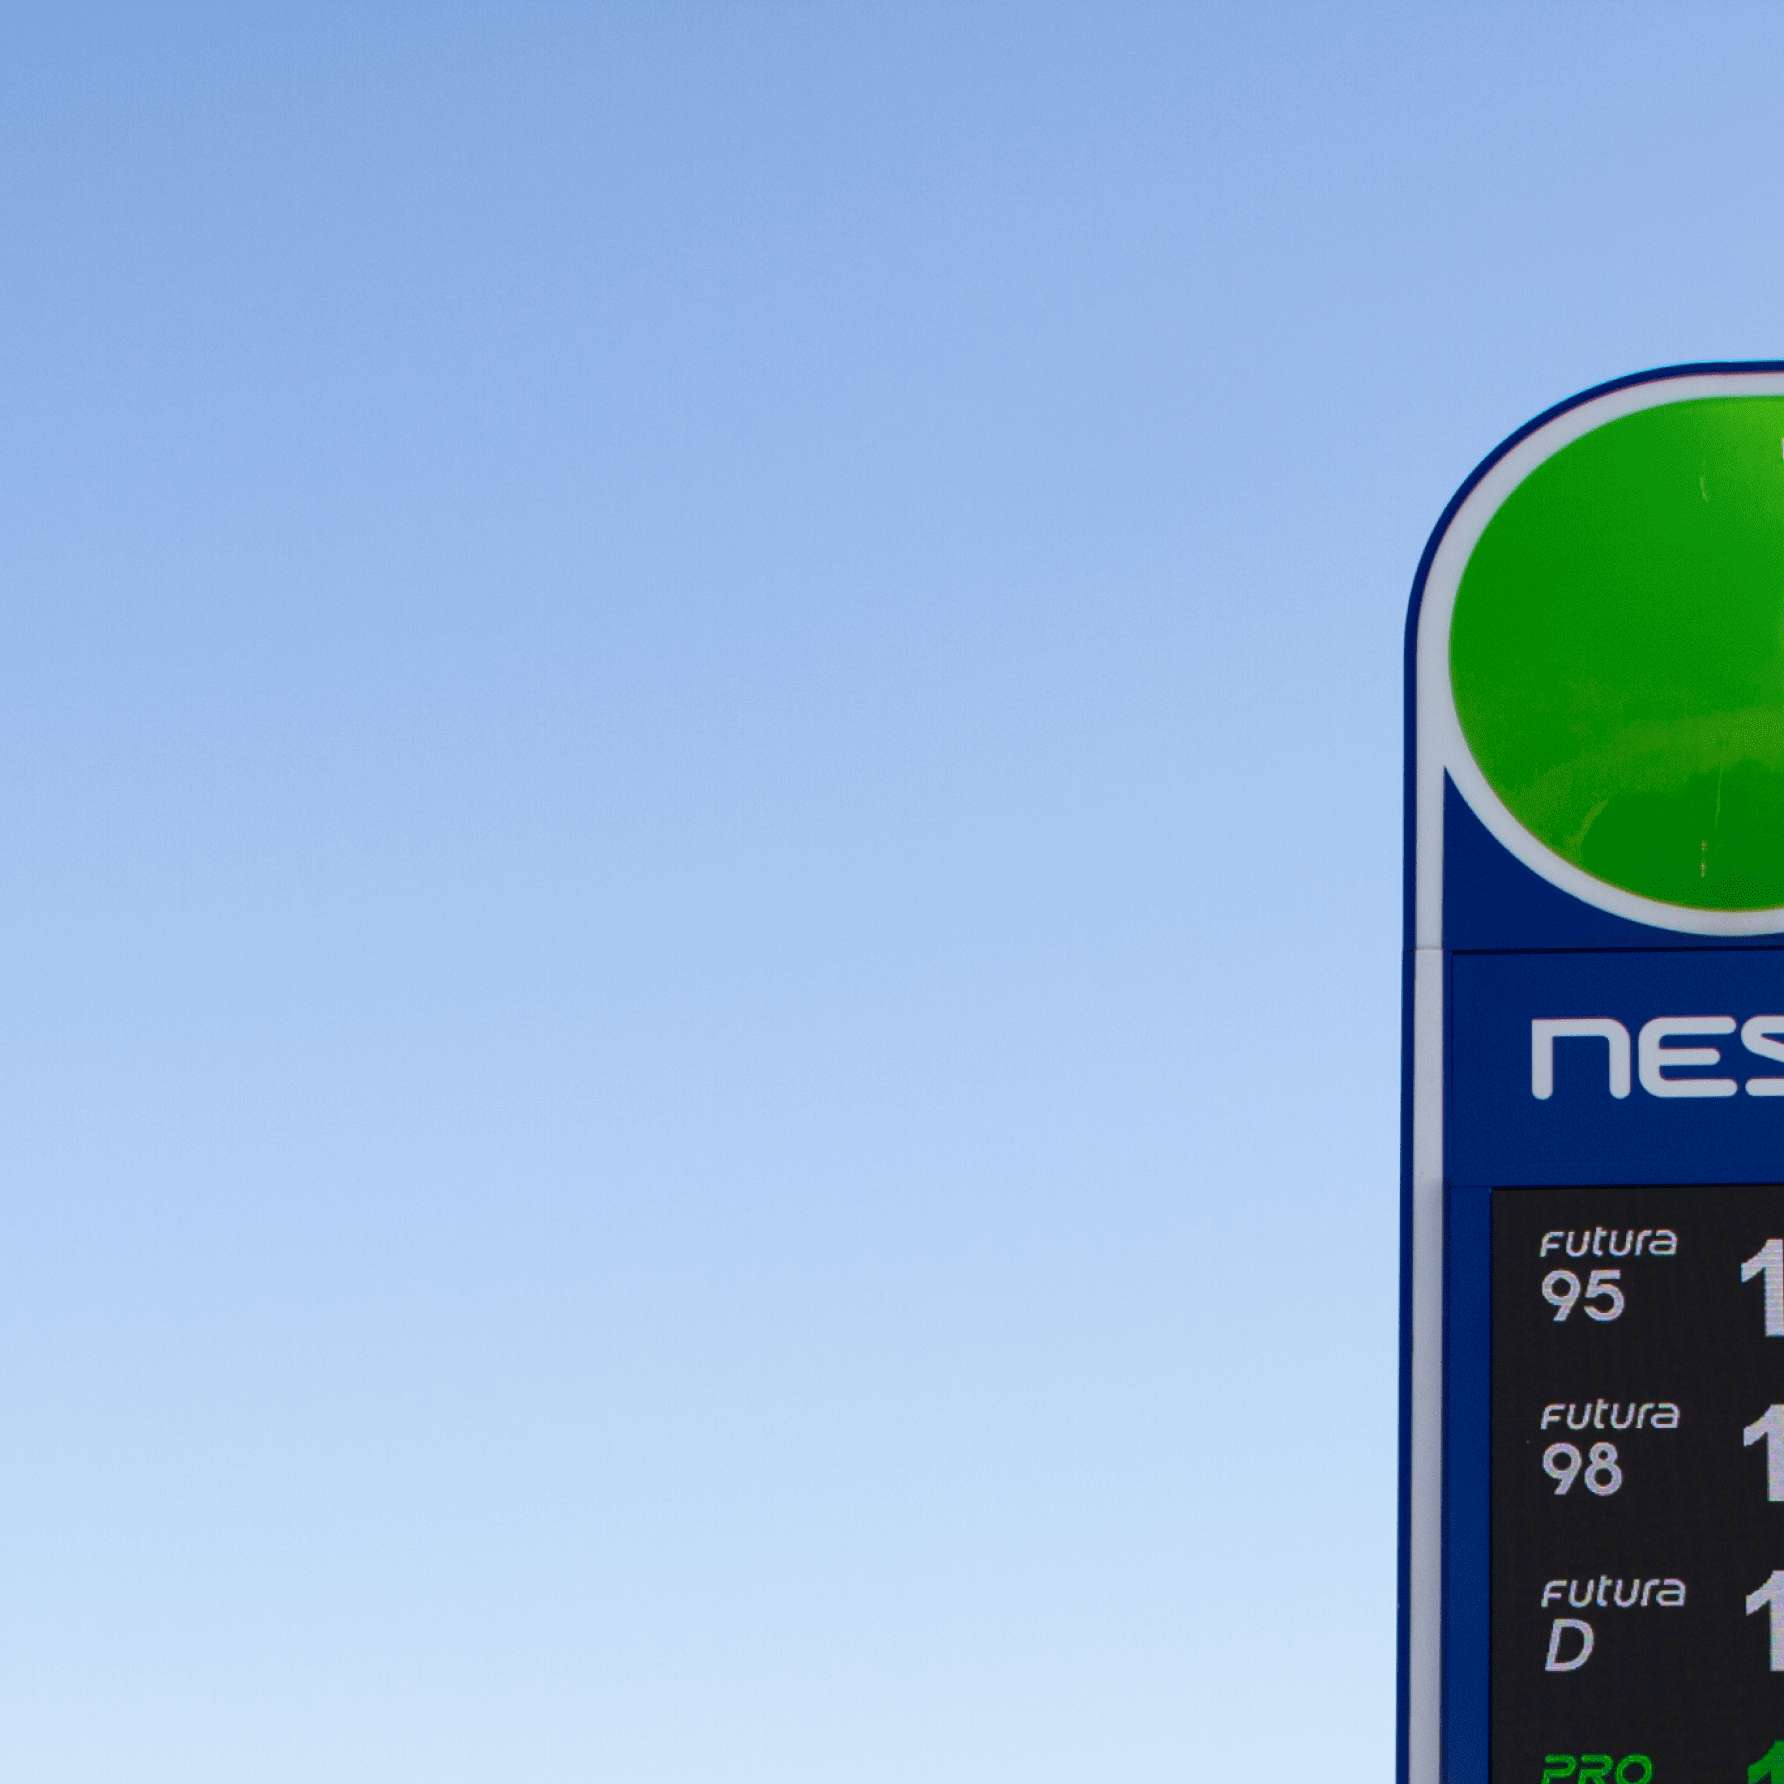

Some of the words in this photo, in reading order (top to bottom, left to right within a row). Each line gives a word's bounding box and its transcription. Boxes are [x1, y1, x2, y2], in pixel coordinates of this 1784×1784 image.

[1539, 1226, 1678, 1258] Futura
[1541, 1269, 1626, 1322] 95
[1540, 1398, 1680, 1430] Futura
[1542, 1442, 1623, 1496] 98
[1540, 1574, 1687, 1608] Futura
[1544, 1618, 1594, 1672] D
